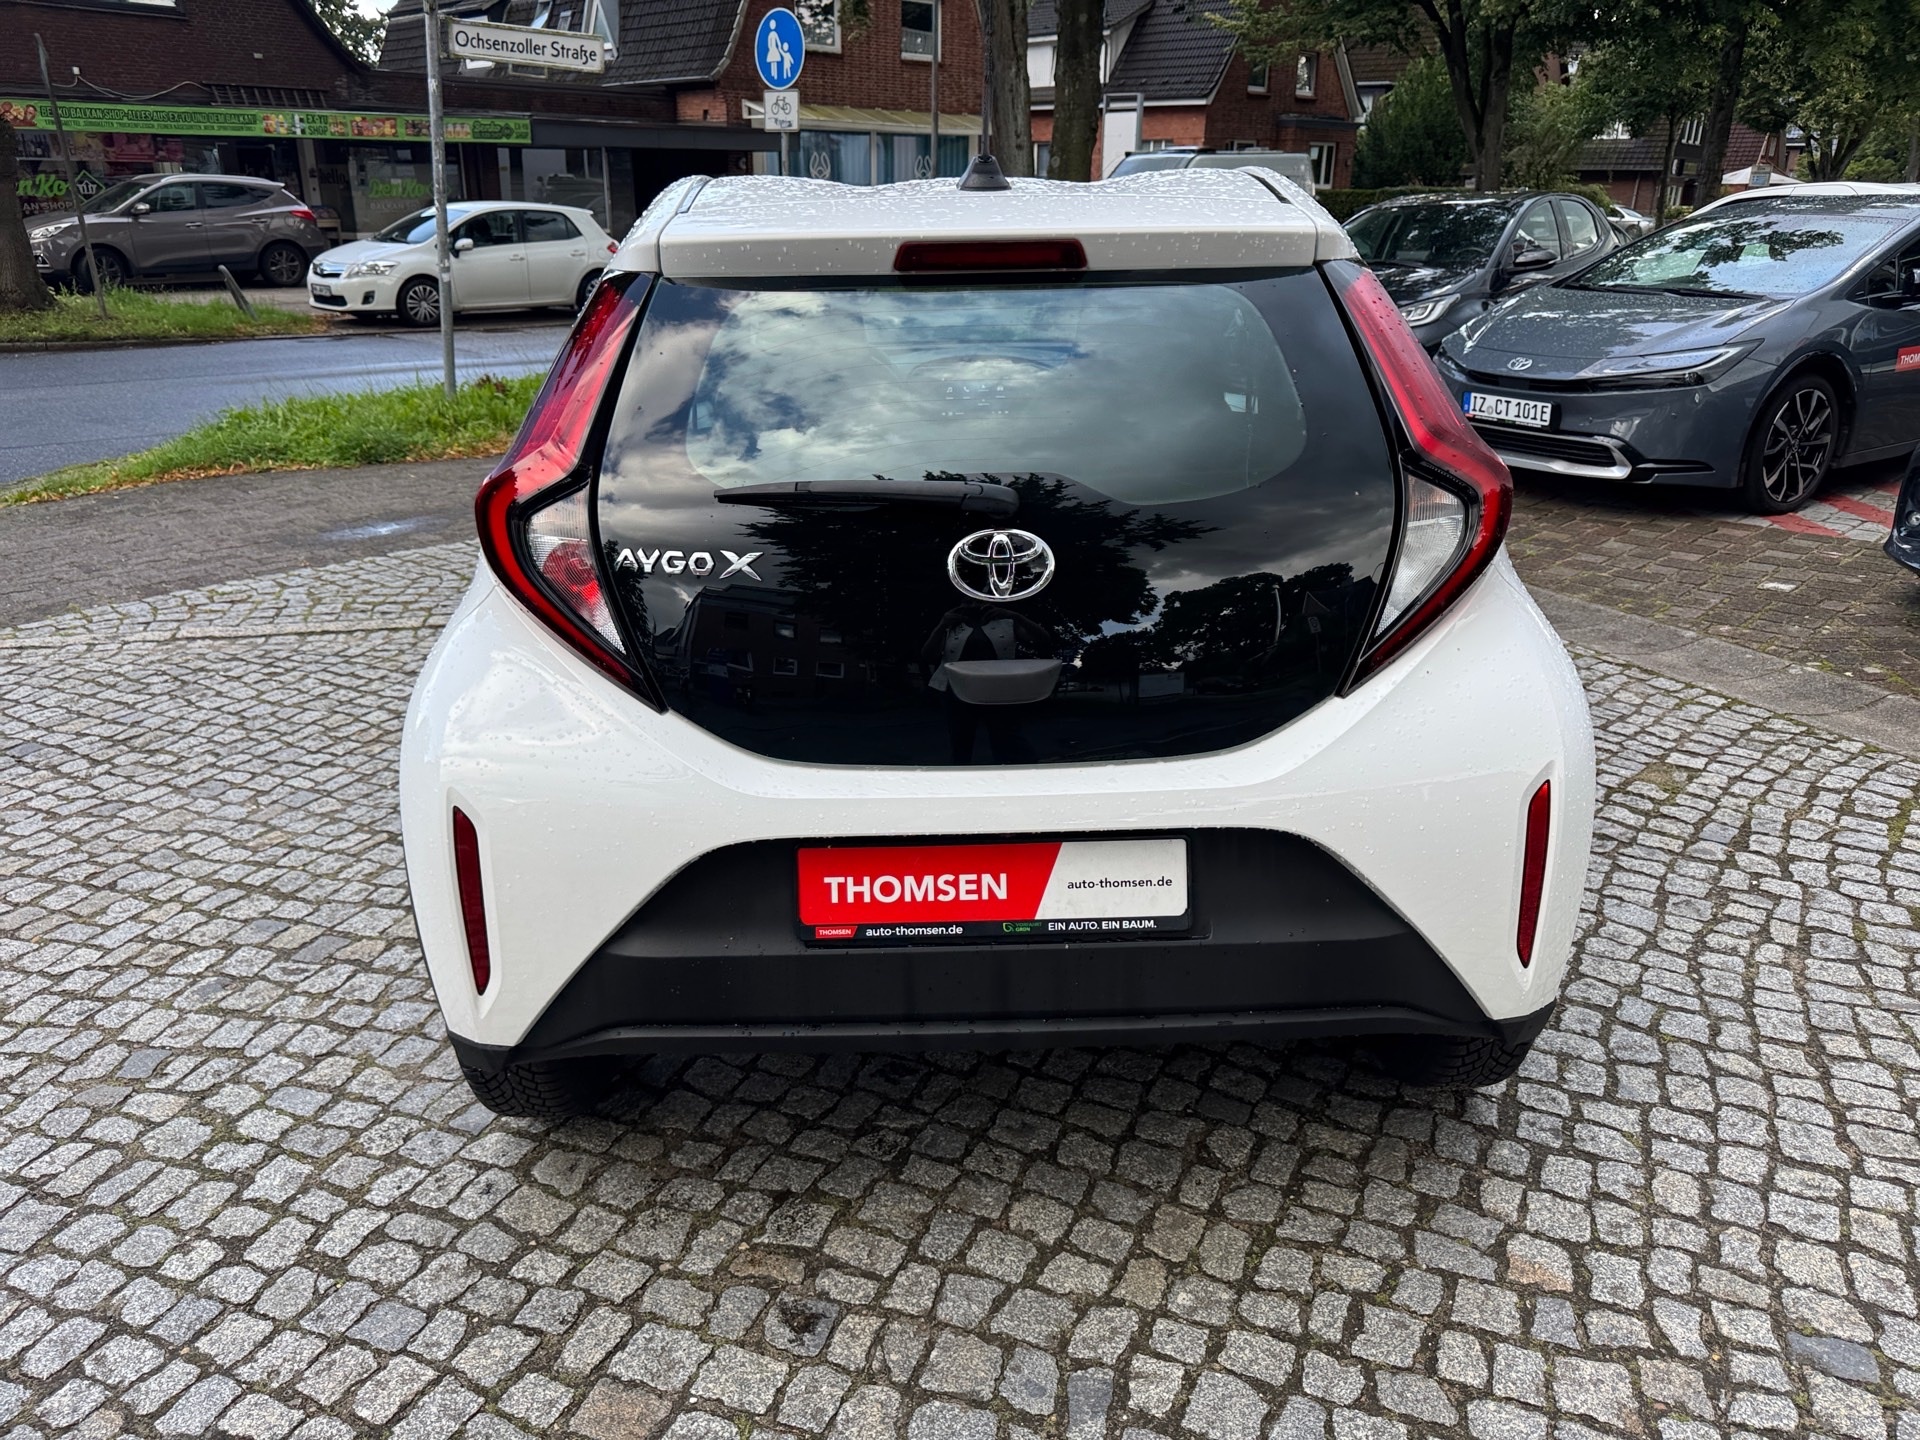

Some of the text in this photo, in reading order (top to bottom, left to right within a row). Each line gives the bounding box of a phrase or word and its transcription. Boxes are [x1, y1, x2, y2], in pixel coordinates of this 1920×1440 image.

[455, 30, 597, 65] Ochsenzoller Straße
[41, 106, 69, 117] BEKO
[70, 108, 103, 119] BALKAN
[153, 111, 168, 121] AUS
[192, 113, 208, 123] UND
[209, 113, 225, 124] DEM
[307, 125, 328, 136] SHOP
[42, 201, 73, 210] SHOP
[1472, 396, 1487, 413] IZ
[1495, 399, 1511, 417] CT
[614, 547, 764, 581] AYGO X
[823, 873, 1008, 904] THOMSEN
[1067, 876, 1173, 889] auto-thomsen.de
[819, 925, 963, 936] THOMSEN auto-thomsen.de
[1048, 920, 1157, 931] EIN AUTO. EIN BAUM.
